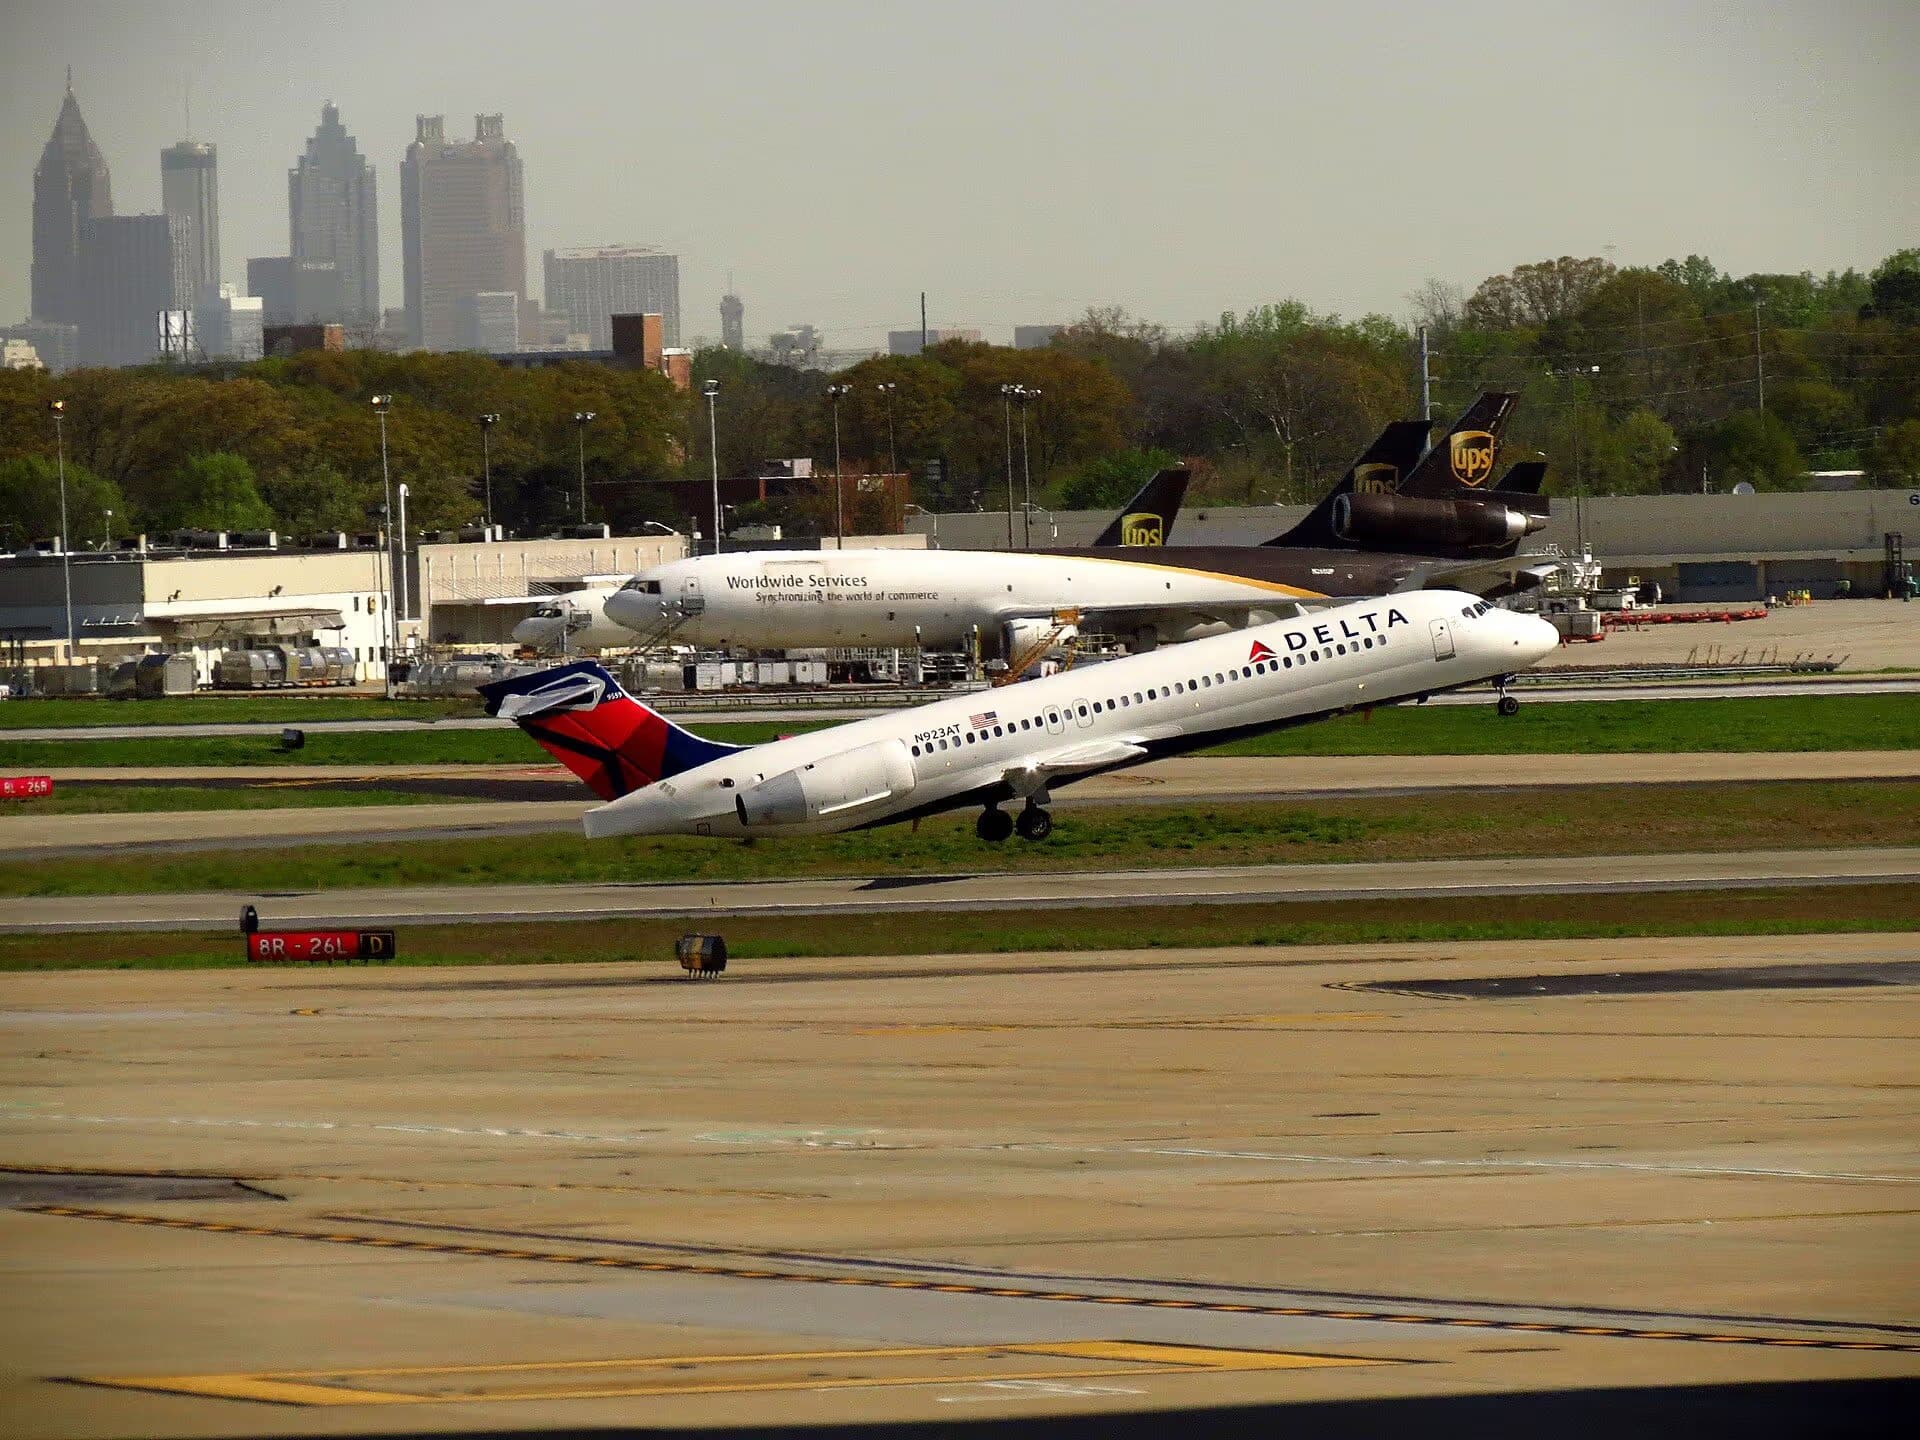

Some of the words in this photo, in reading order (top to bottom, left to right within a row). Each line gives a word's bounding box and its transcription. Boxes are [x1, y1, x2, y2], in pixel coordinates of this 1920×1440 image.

[726, 574, 804, 589] Worldwide
[808, 574, 868, 588] Services
[756, 591, 824, 604] Synchronizing
[827, 591, 843, 601] the
[846, 591, 873, 601] world
[875, 591, 885, 601] of
[887, 592, 939, 601] commerce
[1283, 607, 1409, 651] DELTA
[914, 723, 960, 743] N923AT
[259, 938, 285, 955] 8R
[309, 937, 348, 955] 26L
[369, 936, 383, 953] D
